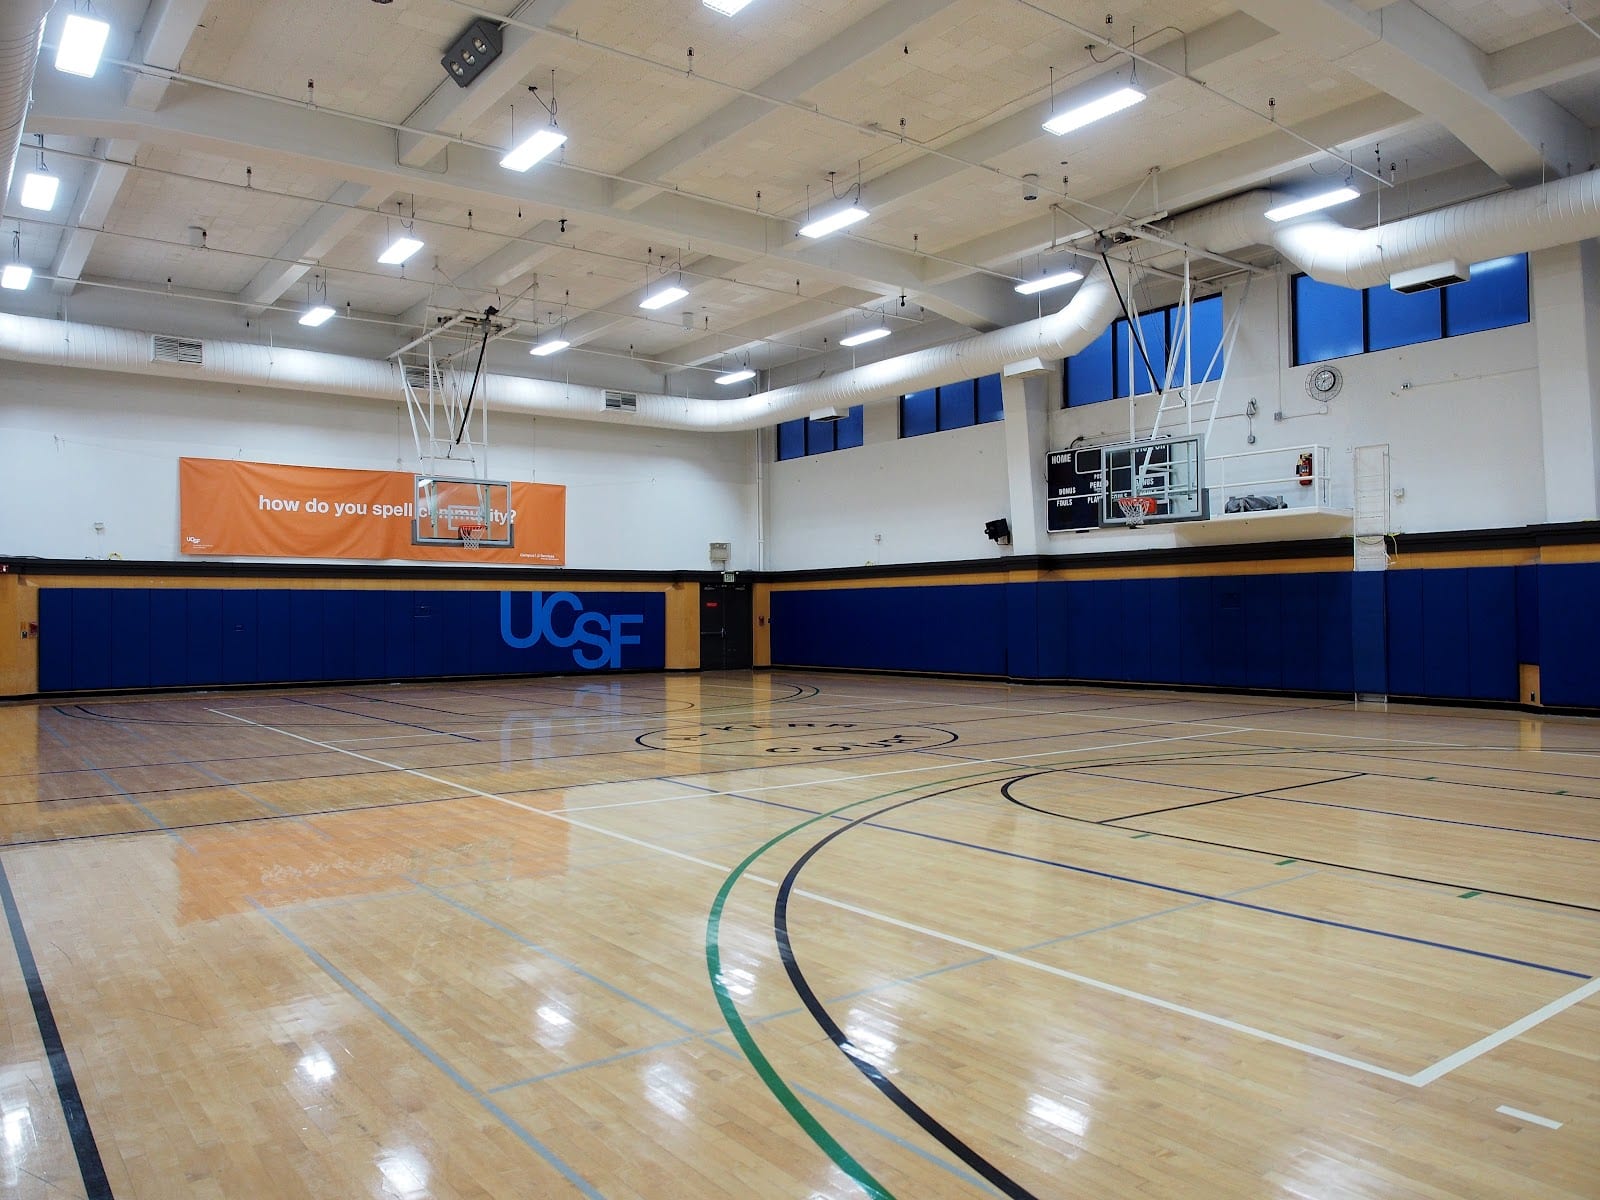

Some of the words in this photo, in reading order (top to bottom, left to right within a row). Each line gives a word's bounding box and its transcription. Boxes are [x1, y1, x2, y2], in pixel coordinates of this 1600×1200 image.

[1051, 454, 1072, 464] HOME
[1058, 487, 1076, 495] BONUS
[258, 494, 300, 512] how
[305, 497, 329, 513] do
[334, 501, 368, 517] you
[372, 501, 413, 518] spell
[1056, 499, 1073, 507] FOULS
[500, 591, 643, 669] UCSF
[765, 734, 931, 753] COURT
